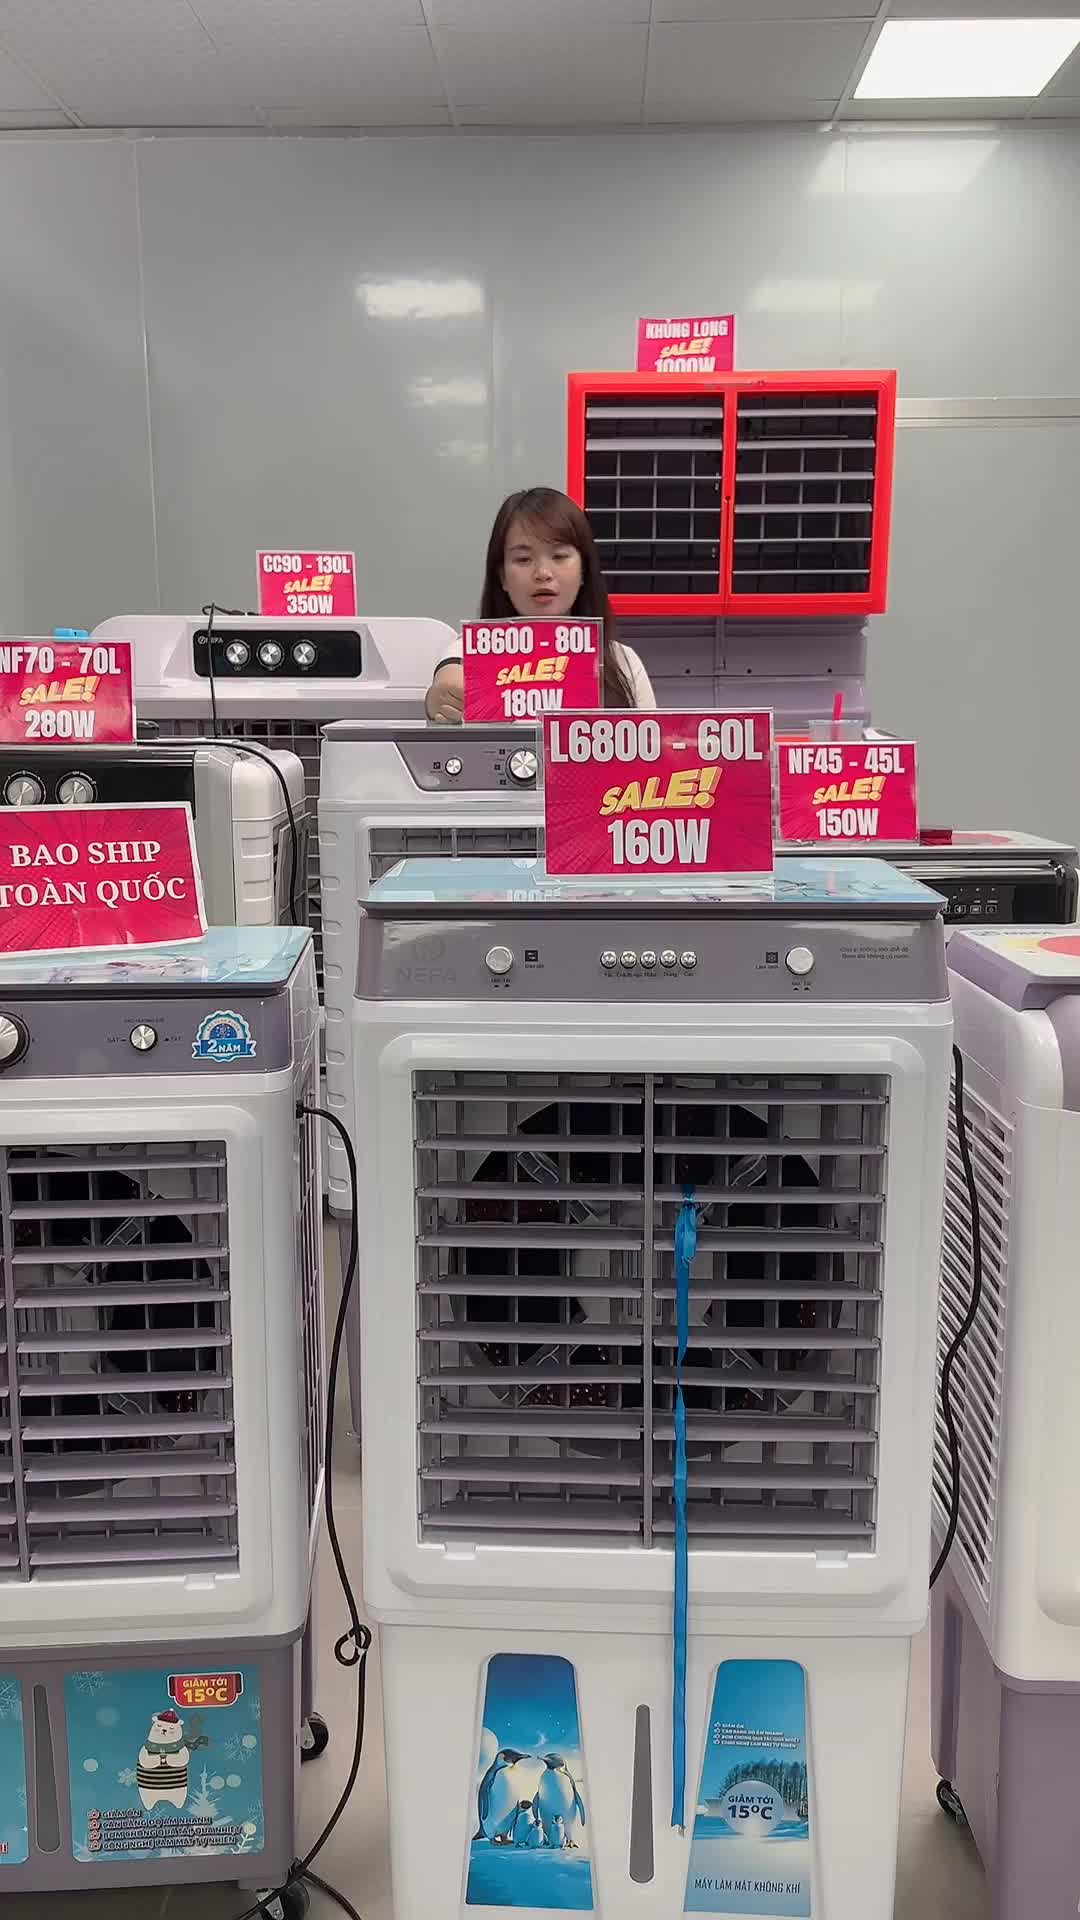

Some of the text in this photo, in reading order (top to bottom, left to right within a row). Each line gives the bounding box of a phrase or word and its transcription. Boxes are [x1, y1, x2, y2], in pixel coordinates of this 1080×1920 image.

[693, 320, 729, 337] LONG
[660, 336, 714, 359] SALE!
[263, 555, 302, 573] CC90
[316, 556, 350, 573] 130L
[284, 575, 334, 593] SALE!
[287, 595, 333, 614] 350W
[465, 626, 534, 654] L8600
[555, 625, 596, 654] 80L
[0, 646, 55, 674] NF70
[78, 647, 121, 674] 70L
[496, 655, 569, 686] SALE!
[19, 676, 101, 705] SALE!
[501, 688, 564, 717] 180W
[25, 709, 95, 738] 280W
[550, 718, 763, 763] L6800 - 60L
[788, 747, 843, 774] NF45
[864, 747, 905, 774] 45L
[599, 766, 723, 816] SALE!
[812, 775, 887, 805] SALE!
[816, 808, 879, 836] 150W
[9, 841, 161, 867] BAO SHIP
[607, 818, 711, 865] 160W
[0, 871, 186, 909] TOÀN QUỐC
[207, 1039, 217, 1053] 2
[211, 1677, 228, 1687] TỚI
